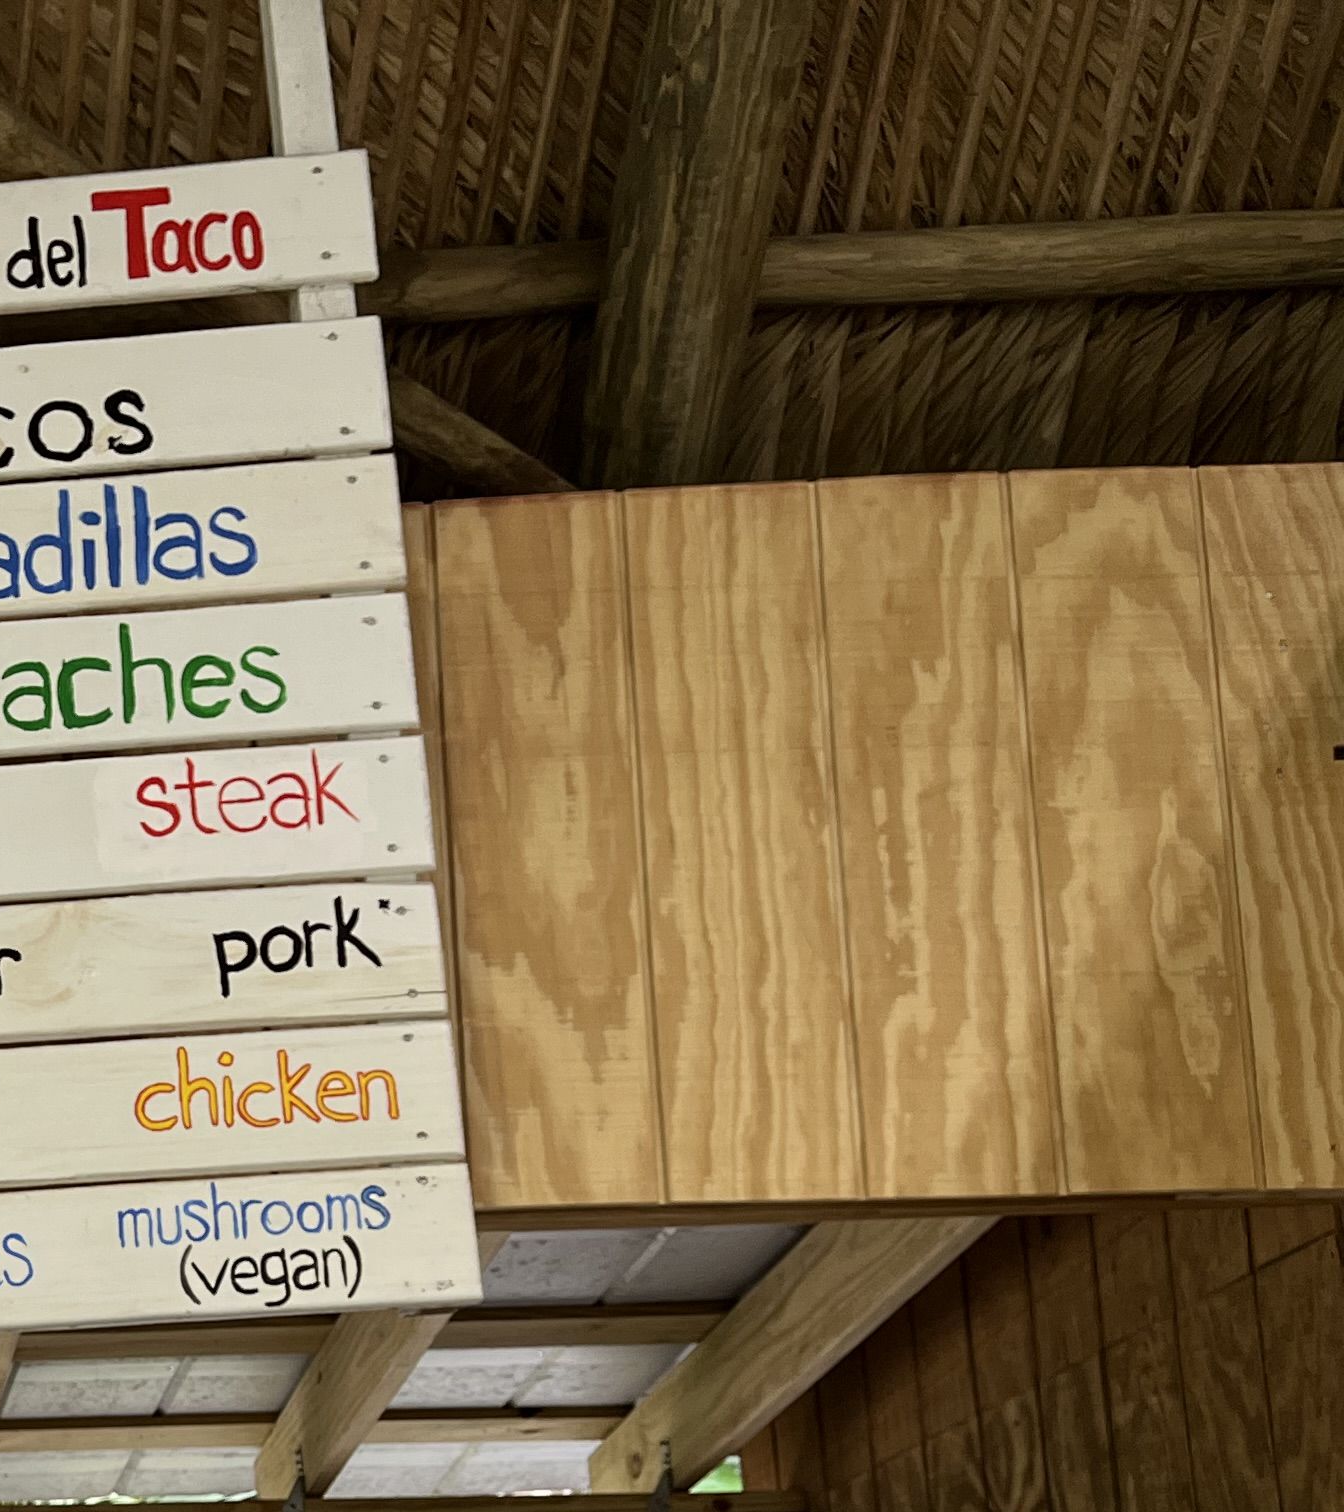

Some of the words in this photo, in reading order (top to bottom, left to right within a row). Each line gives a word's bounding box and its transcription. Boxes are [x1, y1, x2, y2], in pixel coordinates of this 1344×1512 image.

[7, 214, 88, 290] del
[91, 186, 265, 281] Taco
[137, 750, 361, 838] steak
[213, 895, 383, 997] pork
[134, 1045, 401, 1133] chicken
[117, 1182, 391, 1250] mushrooms
[179, 1234, 363, 1307] (vegan)
